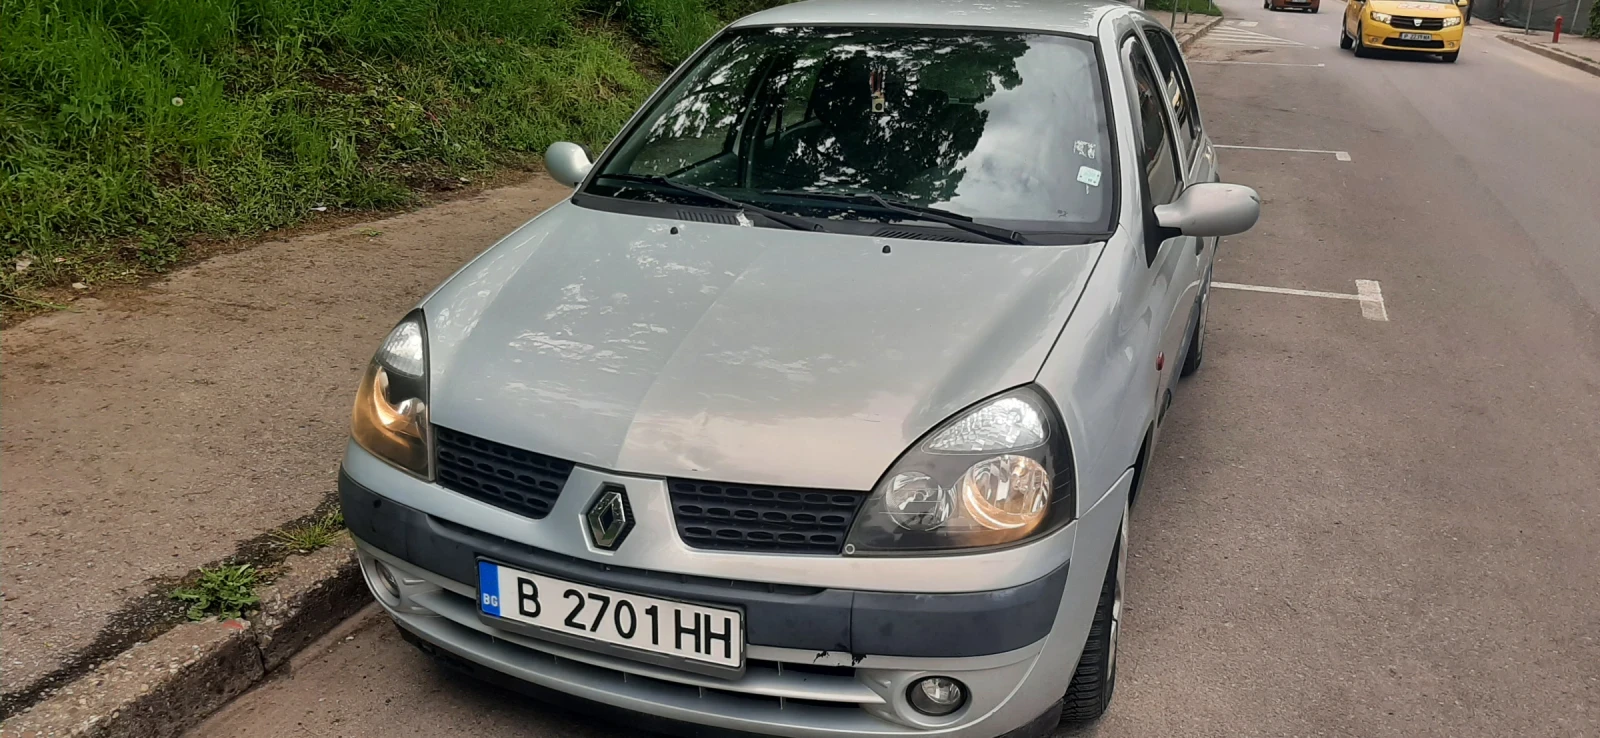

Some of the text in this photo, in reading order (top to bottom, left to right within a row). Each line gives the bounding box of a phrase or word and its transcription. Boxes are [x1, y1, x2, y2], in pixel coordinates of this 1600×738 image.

[483, 593, 498, 607] BG
[518, 577, 731, 659] B 2701 HH
